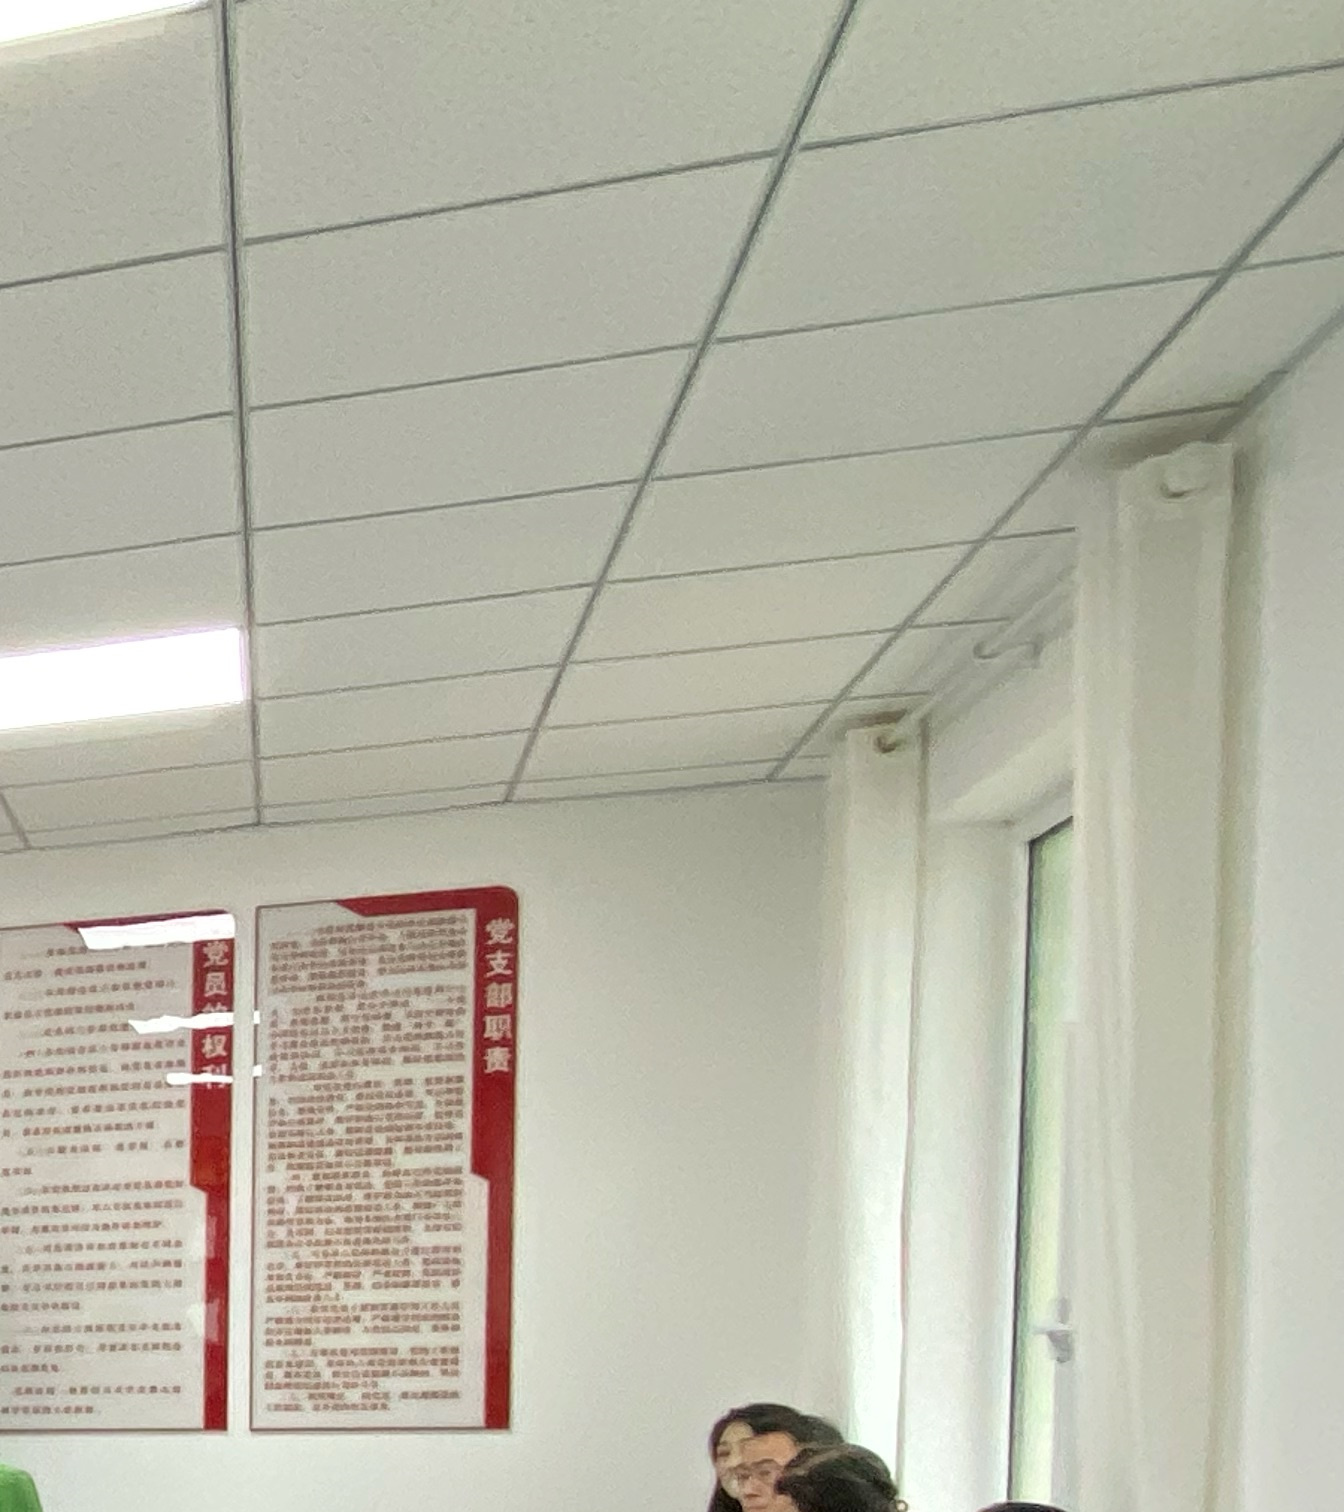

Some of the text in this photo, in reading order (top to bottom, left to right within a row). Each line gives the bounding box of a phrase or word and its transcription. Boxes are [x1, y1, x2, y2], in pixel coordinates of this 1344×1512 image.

[482, 917, 513, 1074] 党支部职责
